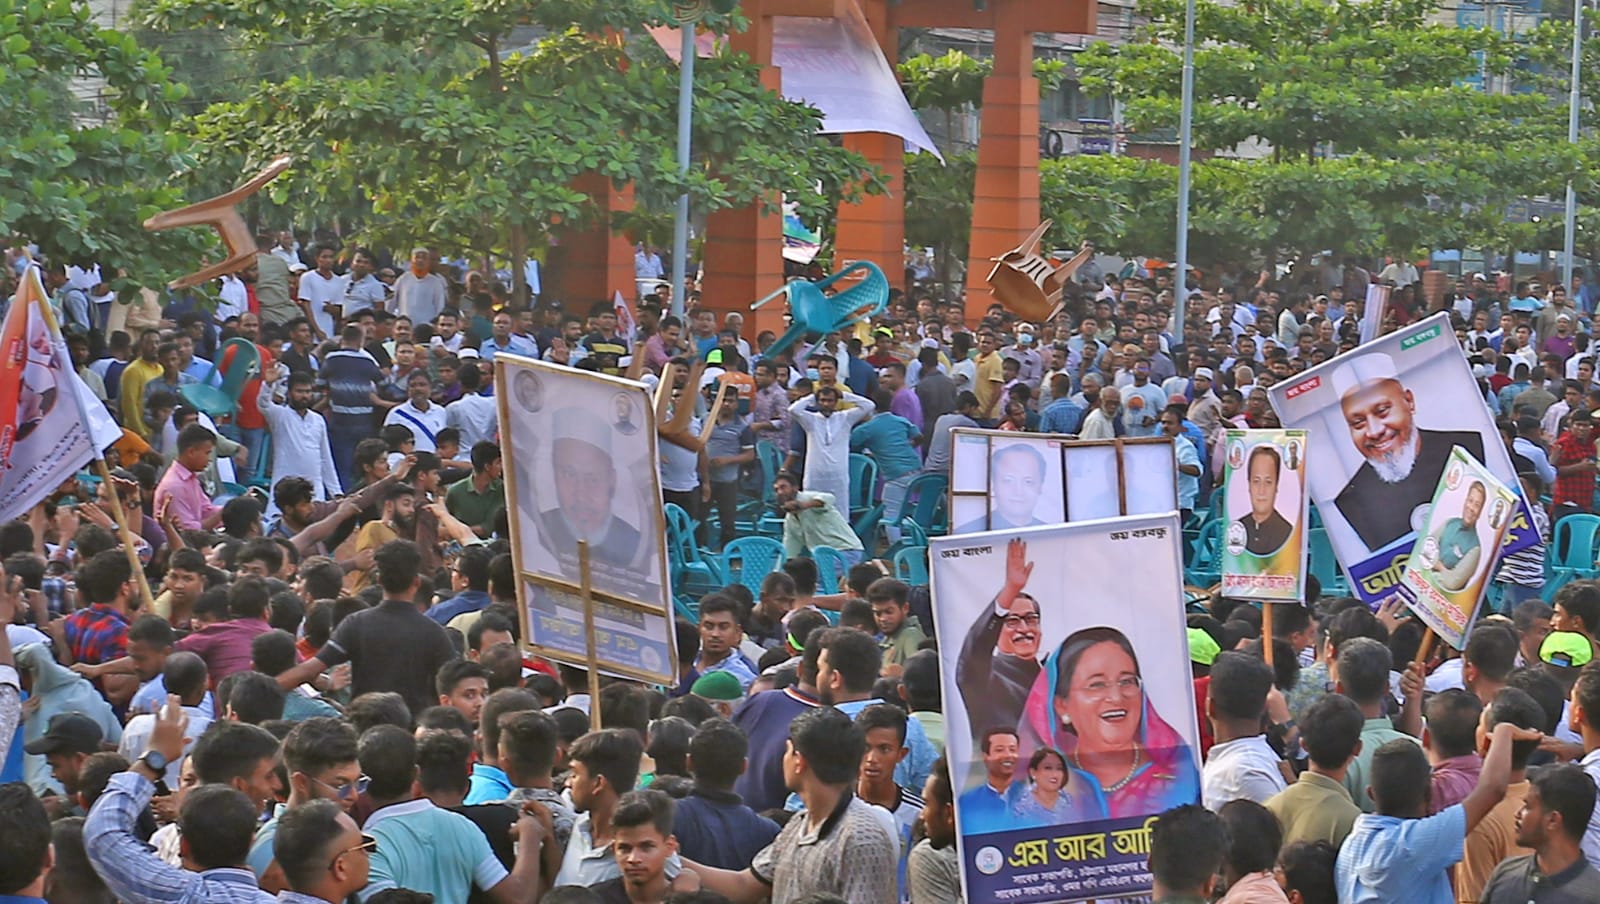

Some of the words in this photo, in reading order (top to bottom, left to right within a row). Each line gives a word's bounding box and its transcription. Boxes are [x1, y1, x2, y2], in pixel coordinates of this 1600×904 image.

[1110, 532, 1128, 540] জয়
[941, 549, 960, 559] জয়
[963, 546, 992, 557] বাংলা
[1008, 840, 1048, 868] এম
[1054, 834, 1106, 861] আর
